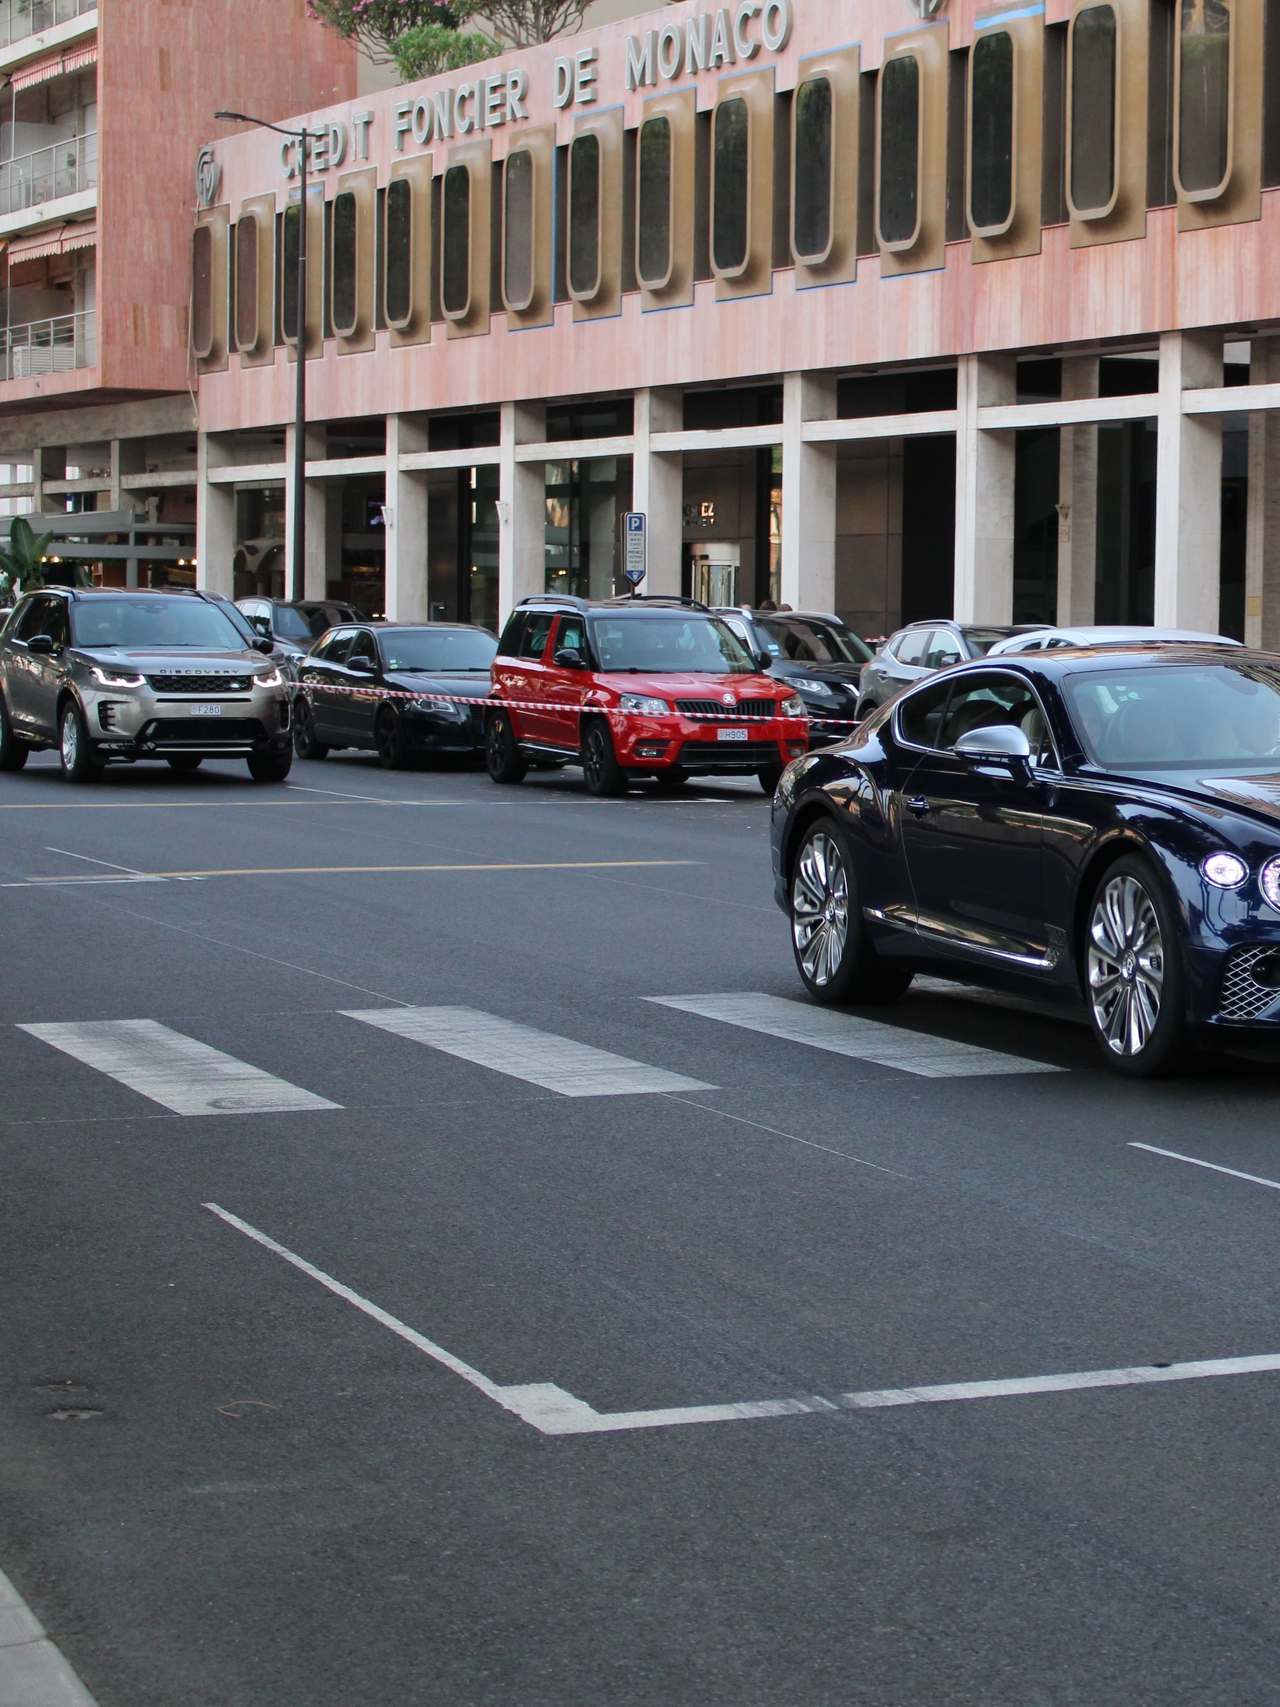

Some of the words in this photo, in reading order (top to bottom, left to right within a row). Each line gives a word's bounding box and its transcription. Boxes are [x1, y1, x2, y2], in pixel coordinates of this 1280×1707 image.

[394, 68, 529, 150] FONCIER
[553, 46, 598, 109] DE
[625, 0, 794, 90] MONACO
[631, 517, 640, 531] P
[198, 705, 220, 714] F280
[725, 730, 747, 739] H905
